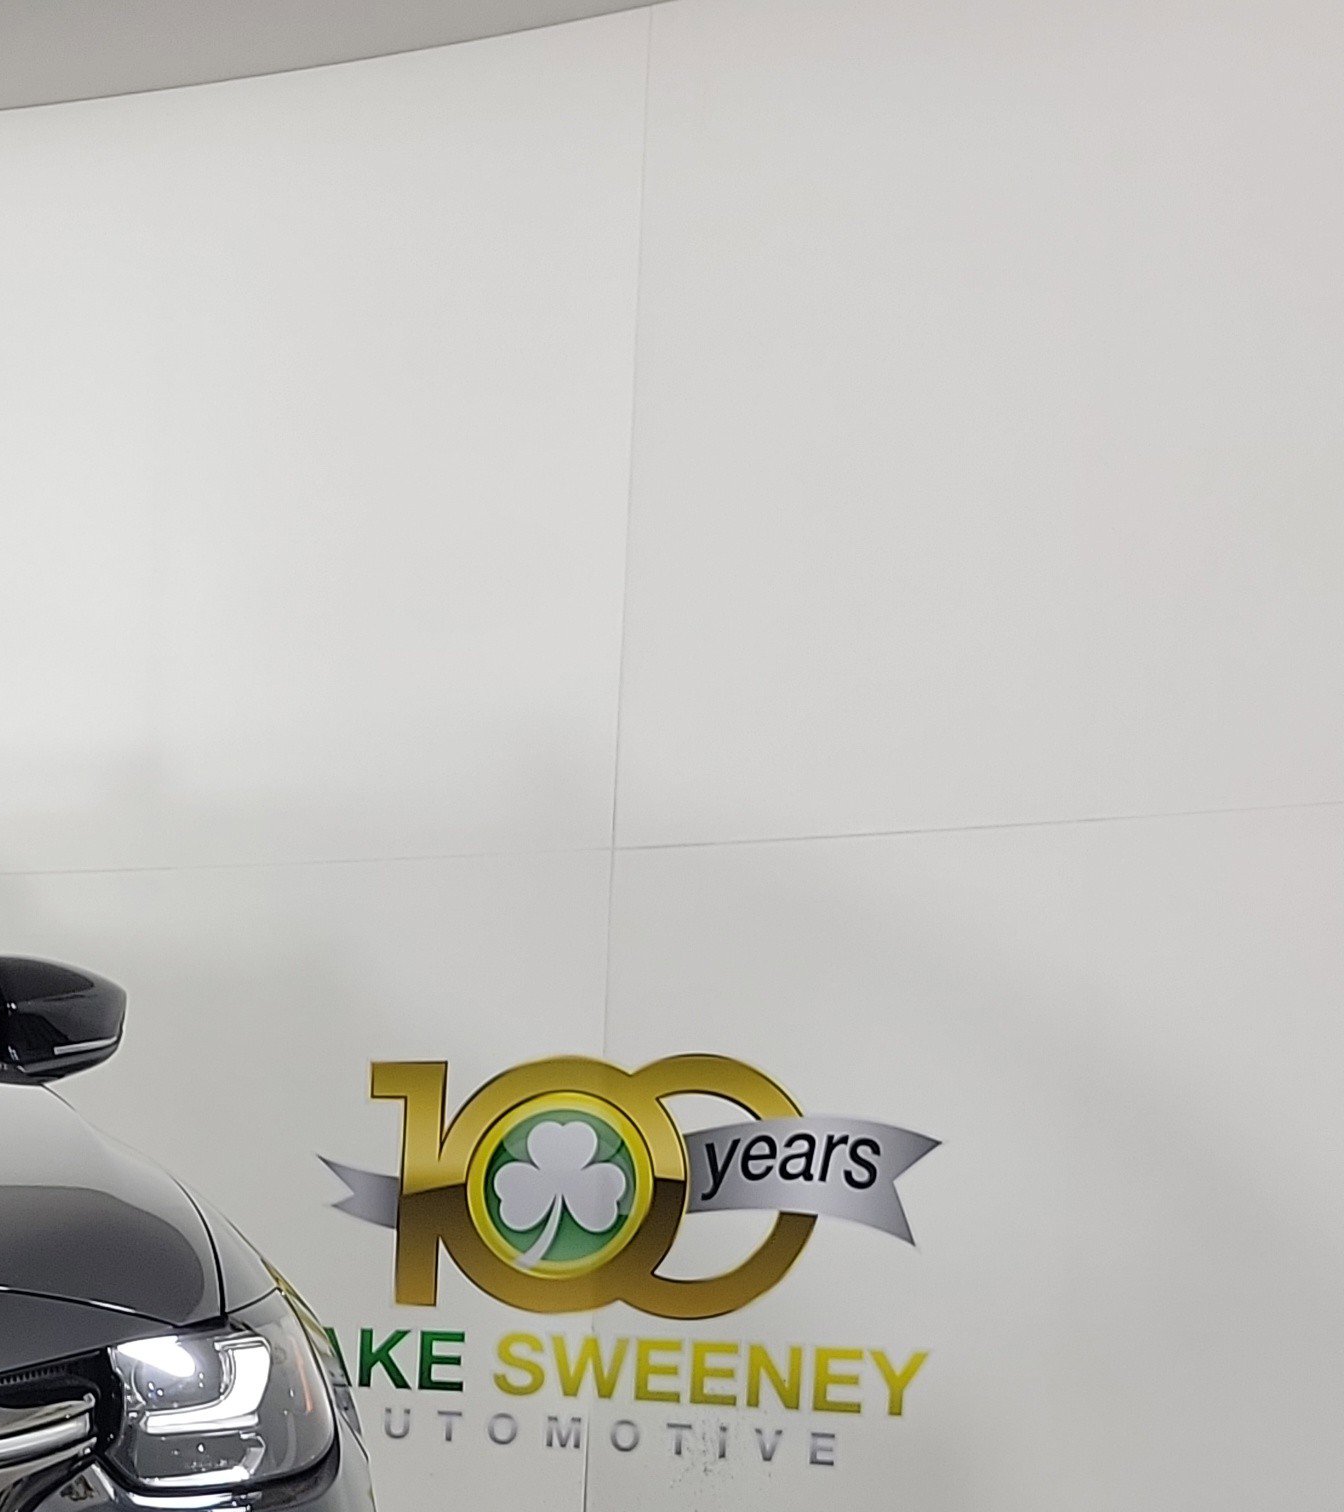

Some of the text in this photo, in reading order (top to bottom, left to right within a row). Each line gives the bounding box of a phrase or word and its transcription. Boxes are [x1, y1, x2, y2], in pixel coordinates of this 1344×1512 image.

[370, 1053, 882, 1321] 100 years
[323, 1326, 930, 1417] KE SWEENEY
[384, 1407, 836, 1467] UTOMOTIVE
